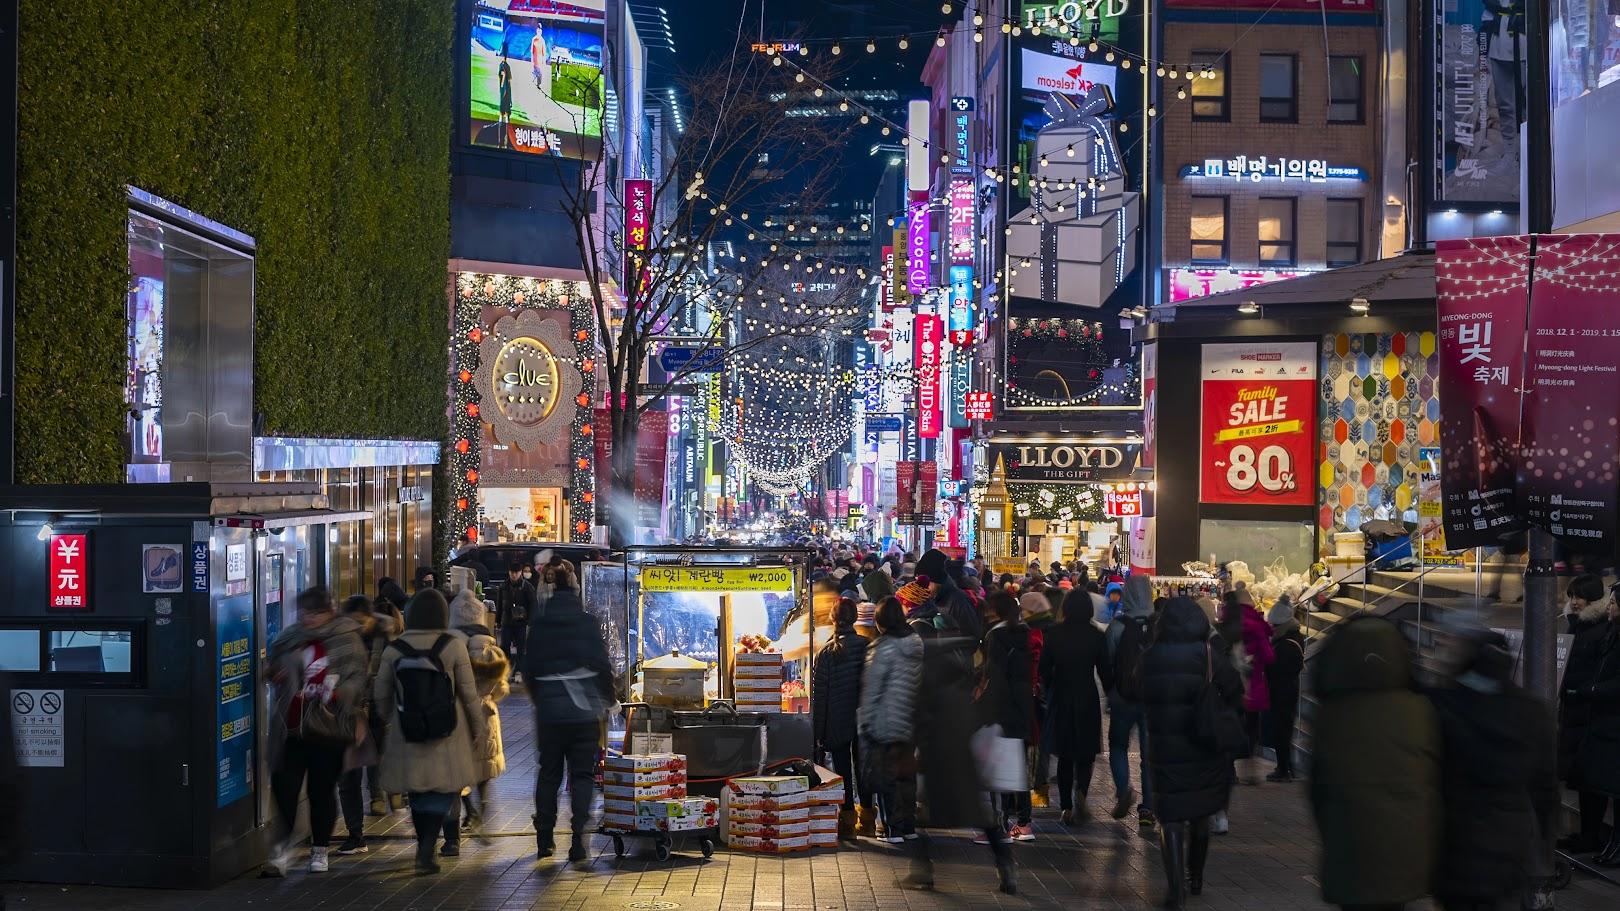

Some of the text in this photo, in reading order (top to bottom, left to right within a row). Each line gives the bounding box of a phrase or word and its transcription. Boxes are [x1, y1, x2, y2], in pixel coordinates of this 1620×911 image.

[1455, 60, 1474, 115] UTILITY
[515, 127, 530, 147] 형이
[1455, 121, 1474, 147] AF1
[1227, 155, 1326, 182] 백명기의원
[1459, 158, 1478, 168] NIKE
[1470, 168, 1488, 180] AIR
[951, 206, 972, 223] 2F
[1441, 312, 1493, 322] MYEONG-DONG
[1441, 328, 1455, 339] 명동
[1458, 321, 1492, 365] 빛
[503, 359, 550, 387] clue
[1473, 366, 1510, 386] 축제
[1237, 386, 1277, 401] Family
[921, 410, 932, 432] Skin
[1228, 396, 1288, 426] SALE
[697, 422, 706, 461] REPUBLIC
[686, 446, 694, 482] ARITAUM
[1018, 446, 1122, 468] LLOYD
[1116, 493, 1139, 503] SALE
[1121, 503, 1135, 514] 50
[194, 545, 208, 590] 상품권
[686, 569, 725, 584] 계란빵
[749, 572, 787, 583] ₩2,000
[57, 569, 79, 590] 元
[54, 595, 82, 606] 상품권
[30, 728, 57, 736] smoking
